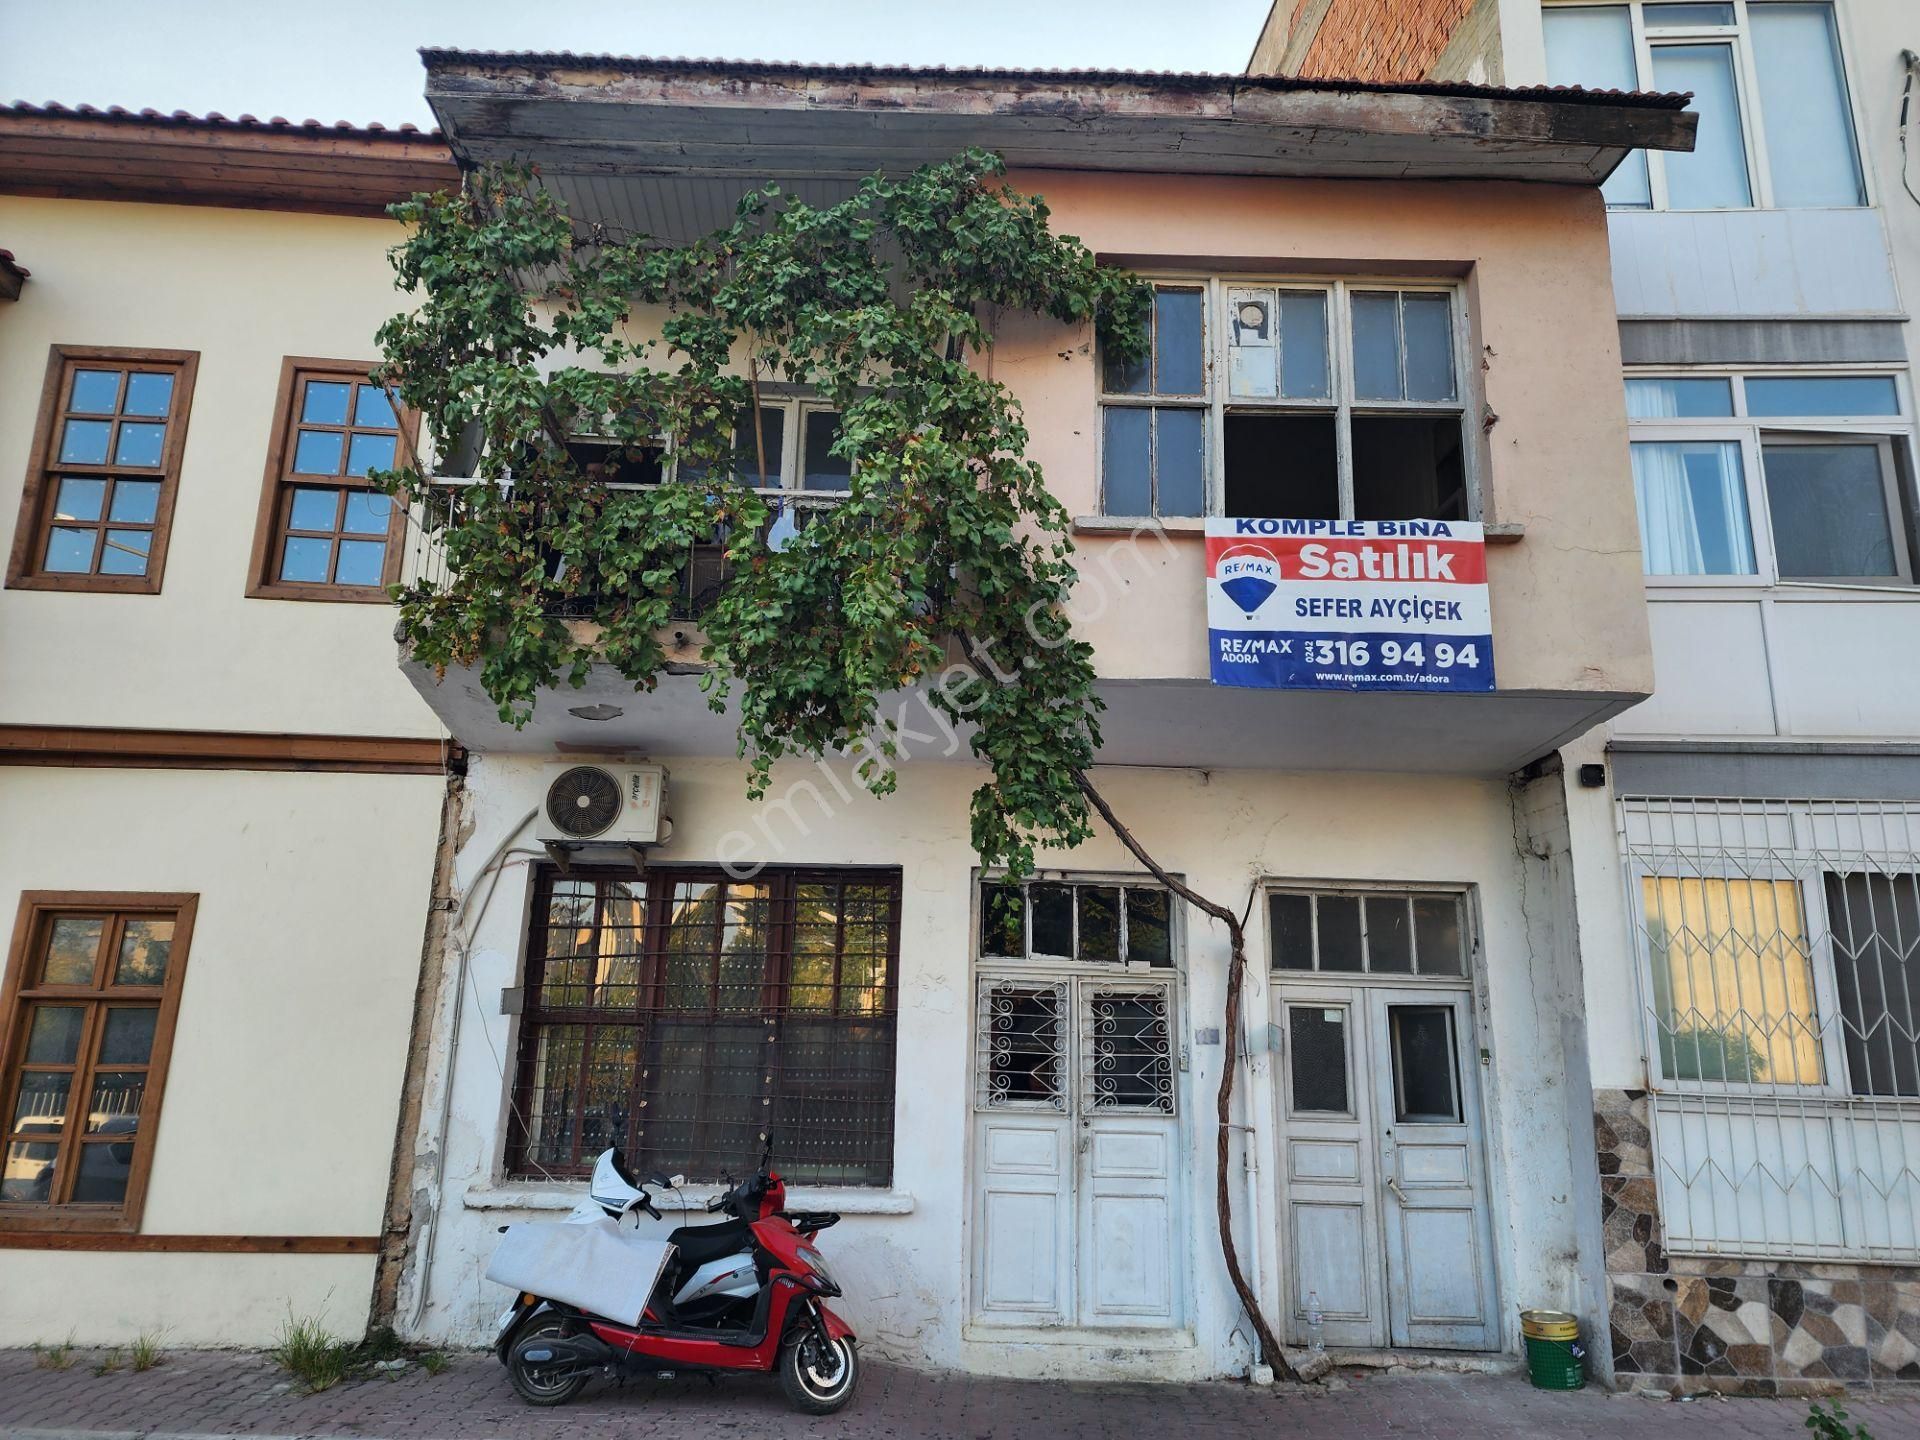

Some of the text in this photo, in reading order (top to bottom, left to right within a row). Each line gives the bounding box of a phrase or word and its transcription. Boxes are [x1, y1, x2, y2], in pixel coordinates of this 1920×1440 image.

[1236, 518, 1365, 537] KOMPLE
[1224, 562, 1273, 576] RE/MAX
[1299, 543, 1457, 581] Satılık
[1295, 594, 1463, 625] SEFER AYÇİÇEK
[1220, 638, 1293, 654] RE/MAX
[1315, 639, 1370, 666] 316
[1381, 640, 1426, 667] 94
[1434, 642, 1480, 669] 94
[1221, 652, 1260, 664] ADORA
[1315, 671, 1450, 684] www.remax.com.tr/adora
